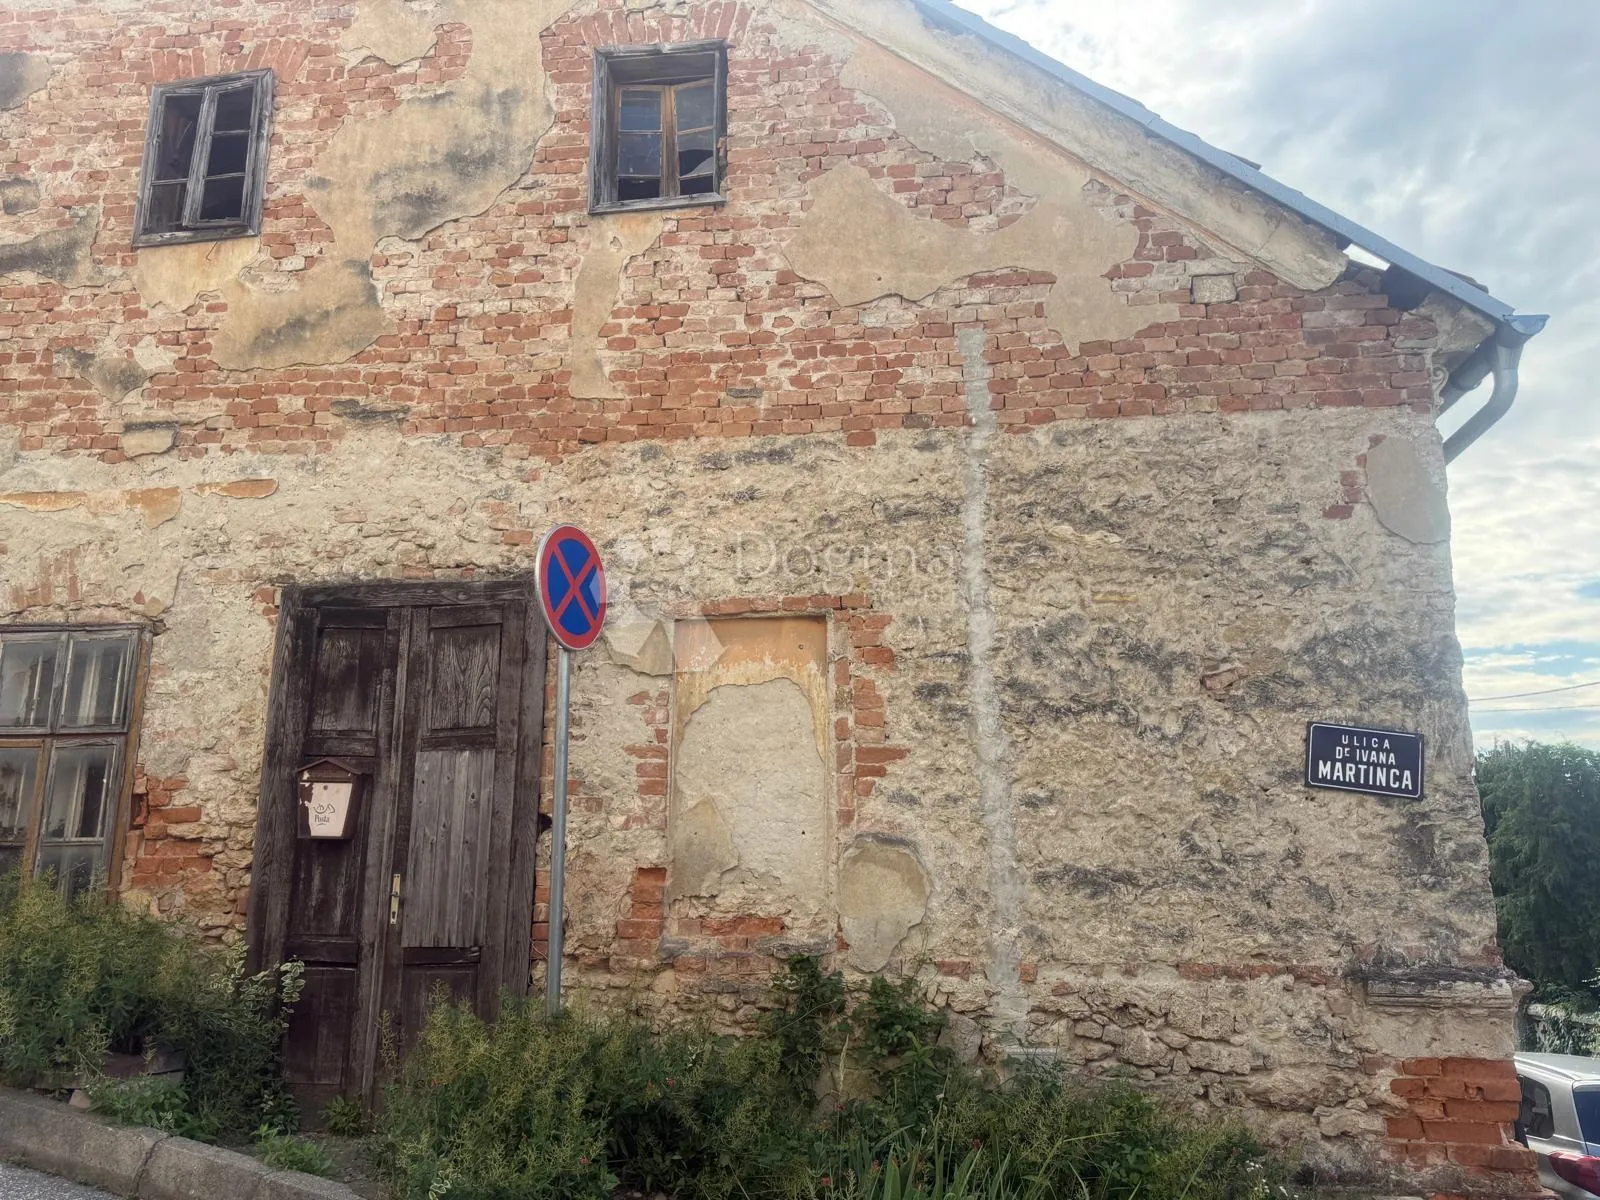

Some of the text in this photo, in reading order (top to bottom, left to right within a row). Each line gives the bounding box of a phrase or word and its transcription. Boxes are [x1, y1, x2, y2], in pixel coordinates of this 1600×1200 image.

[1341, 734, 1390, 750] ULICA
[1356, 749, 1396, 766] IVANA
[1318, 759, 1413, 790] MARTINCA
